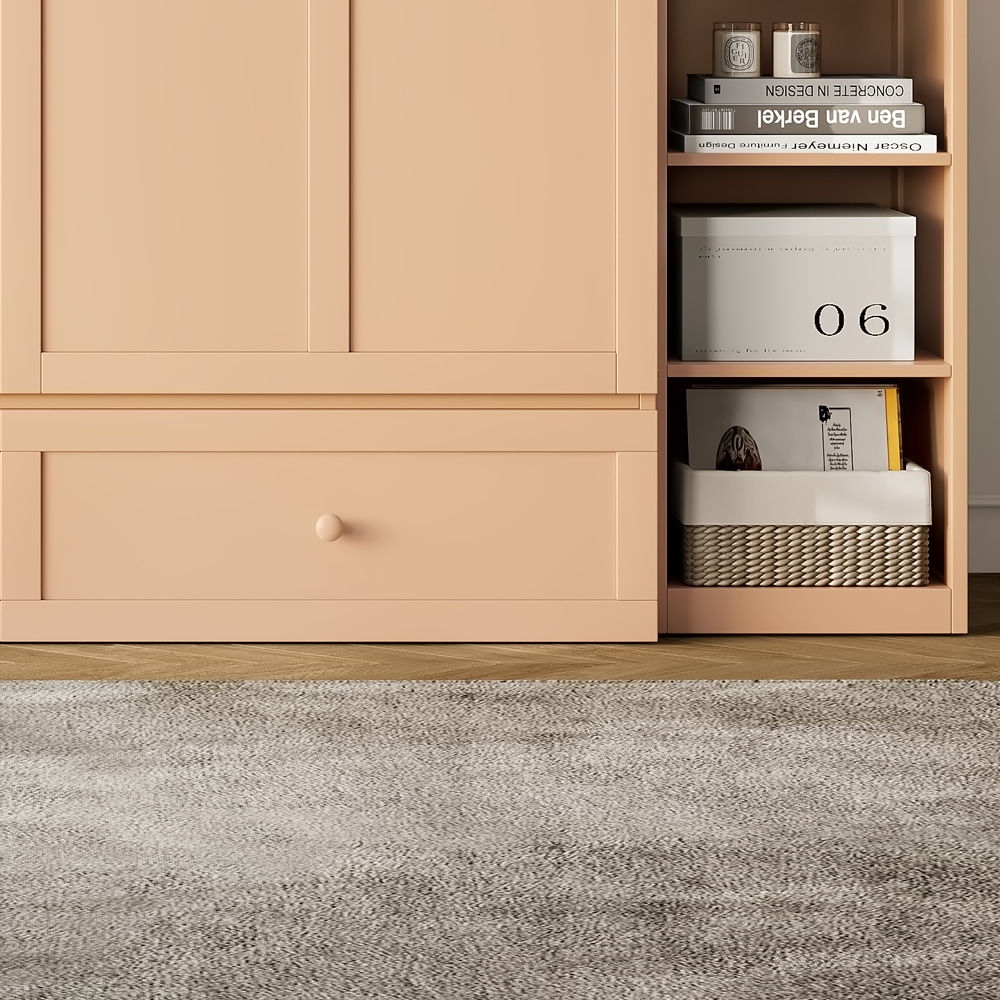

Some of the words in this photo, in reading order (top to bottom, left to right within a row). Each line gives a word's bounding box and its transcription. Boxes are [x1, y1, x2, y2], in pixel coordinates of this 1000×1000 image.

[765, 85, 813, 97] DESIGN
[817, 85, 830, 97] IN
[833, 85, 904, 97] CONCRETE
[757, 109, 819, 129] Berkel
[826, 109, 862, 125] van
[868, 109, 906, 128] Ben
[698, 141, 736, 150] Design
[739, 142, 788, 150] Furniture
[791, 141, 868, 152] Niemeyer
[874, 142, 922, 152] Oscar
